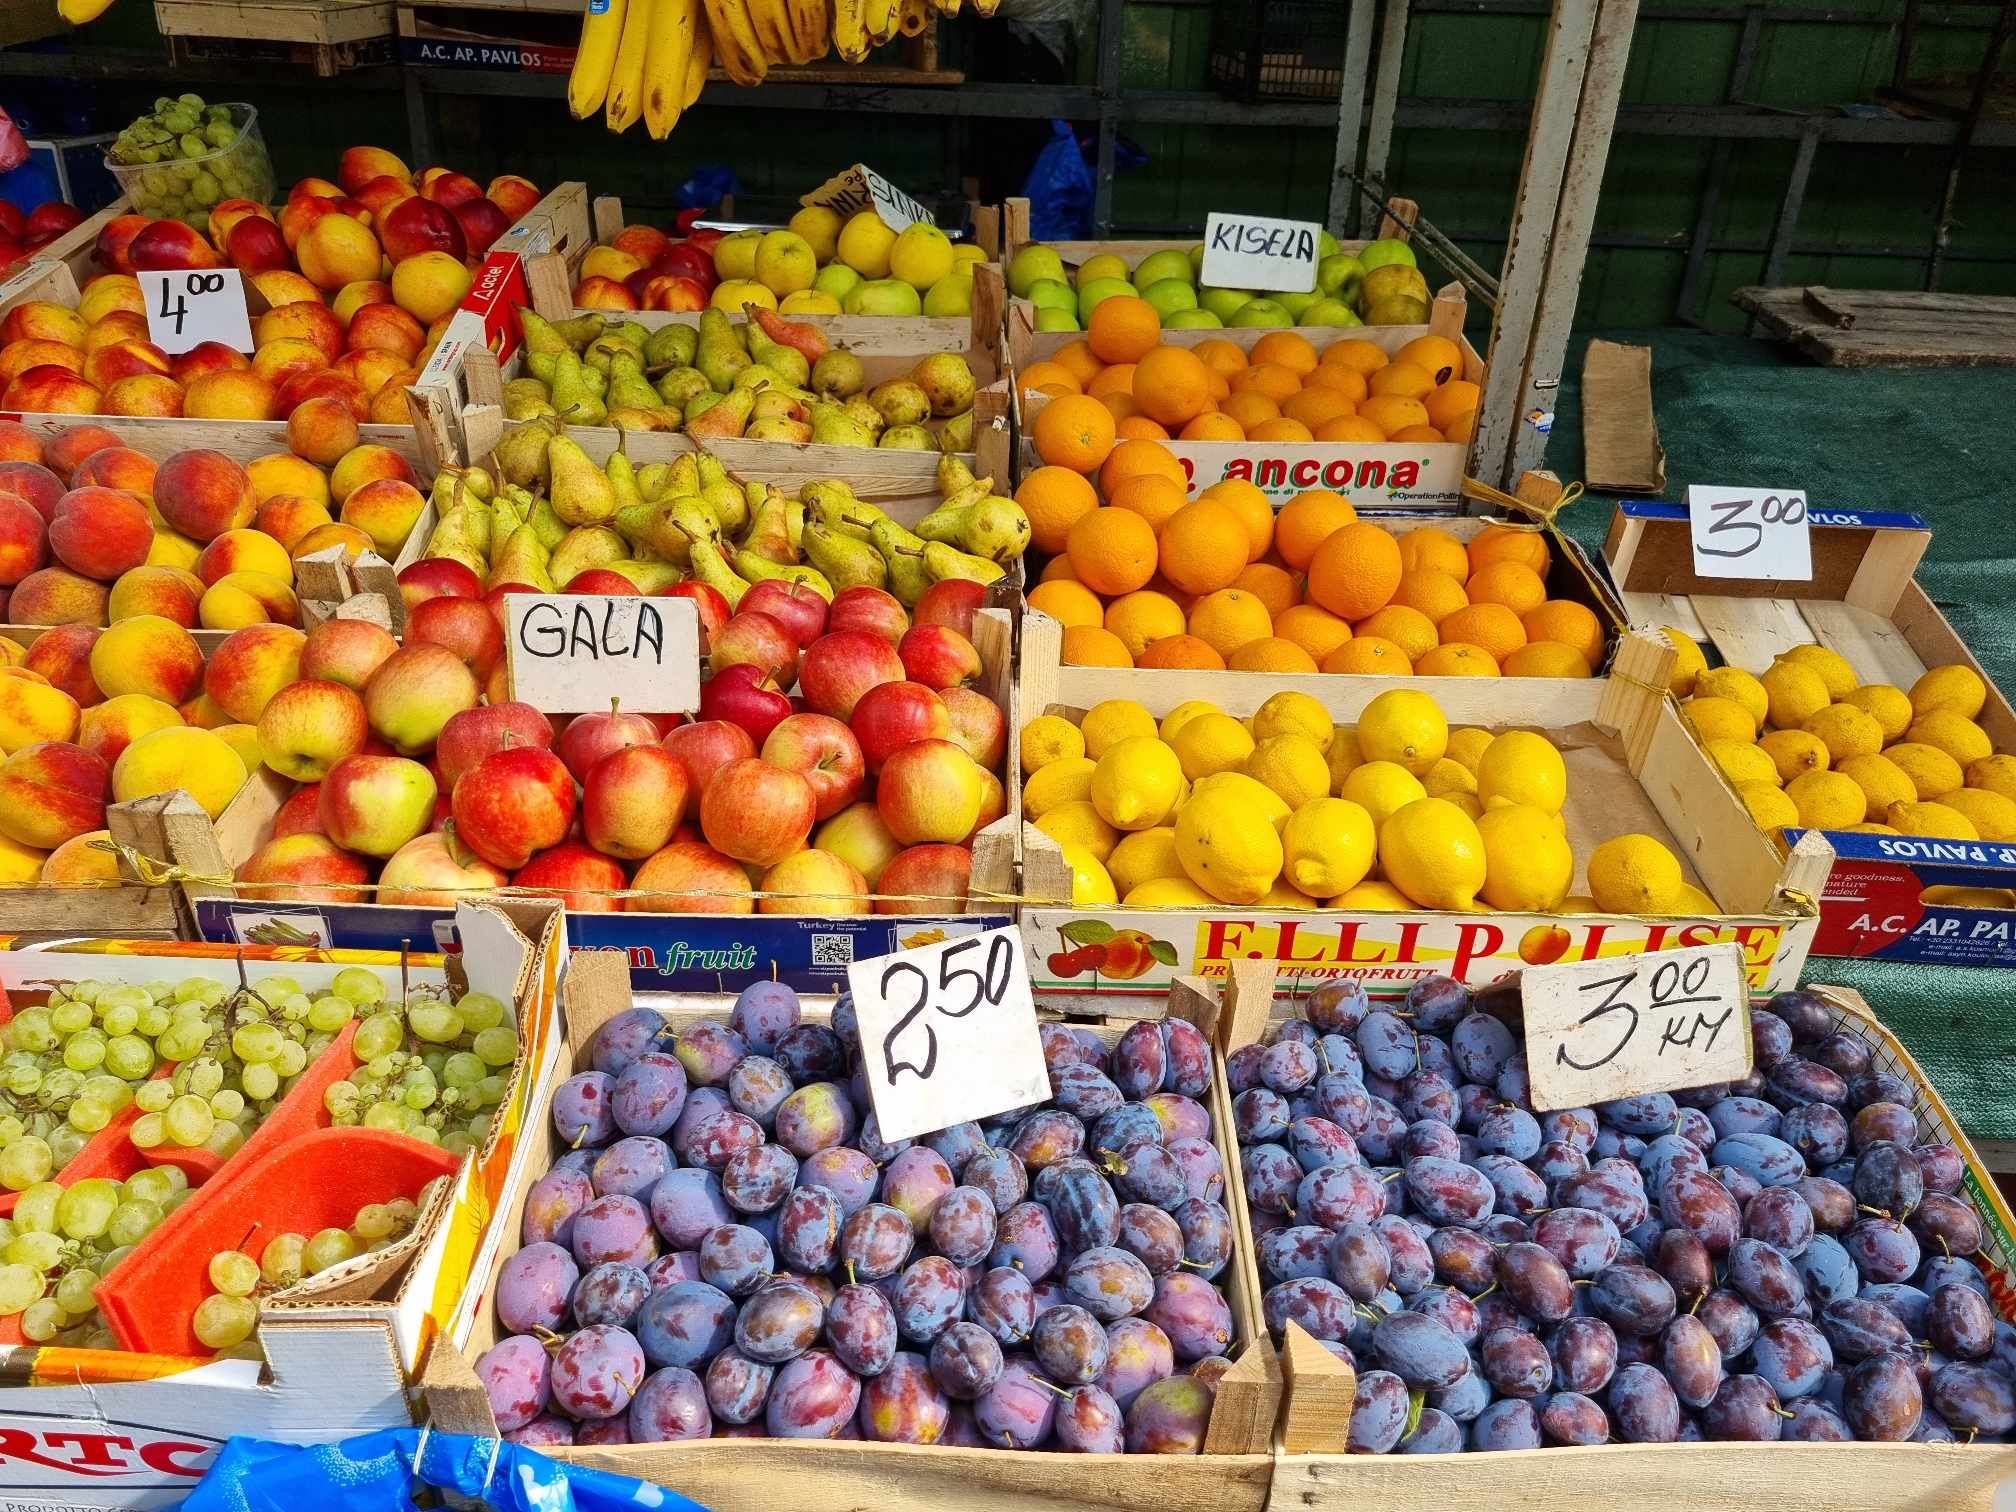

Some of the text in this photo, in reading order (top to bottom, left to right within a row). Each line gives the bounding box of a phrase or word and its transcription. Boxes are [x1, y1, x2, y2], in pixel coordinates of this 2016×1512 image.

[421, 44, 450, 59] A.C.
[455, 47, 477, 62] AP.
[481, 49, 541, 66] PAVLOS
[1212, 222, 1314, 263] KISELA
[1221, 458, 1420, 489] ancona
[1807, 511, 1862, 526] VLOS
[520, 602, 663, 664] GALA
[1879, 839, 1987, 862] PAVLOS
[797, 921, 835, 931] Turkey
[1848, 913, 2016, 940] A.C. AP. PA
[659, 941, 757, 976] fruit
[1658, 1007, 1732, 1056] KM
